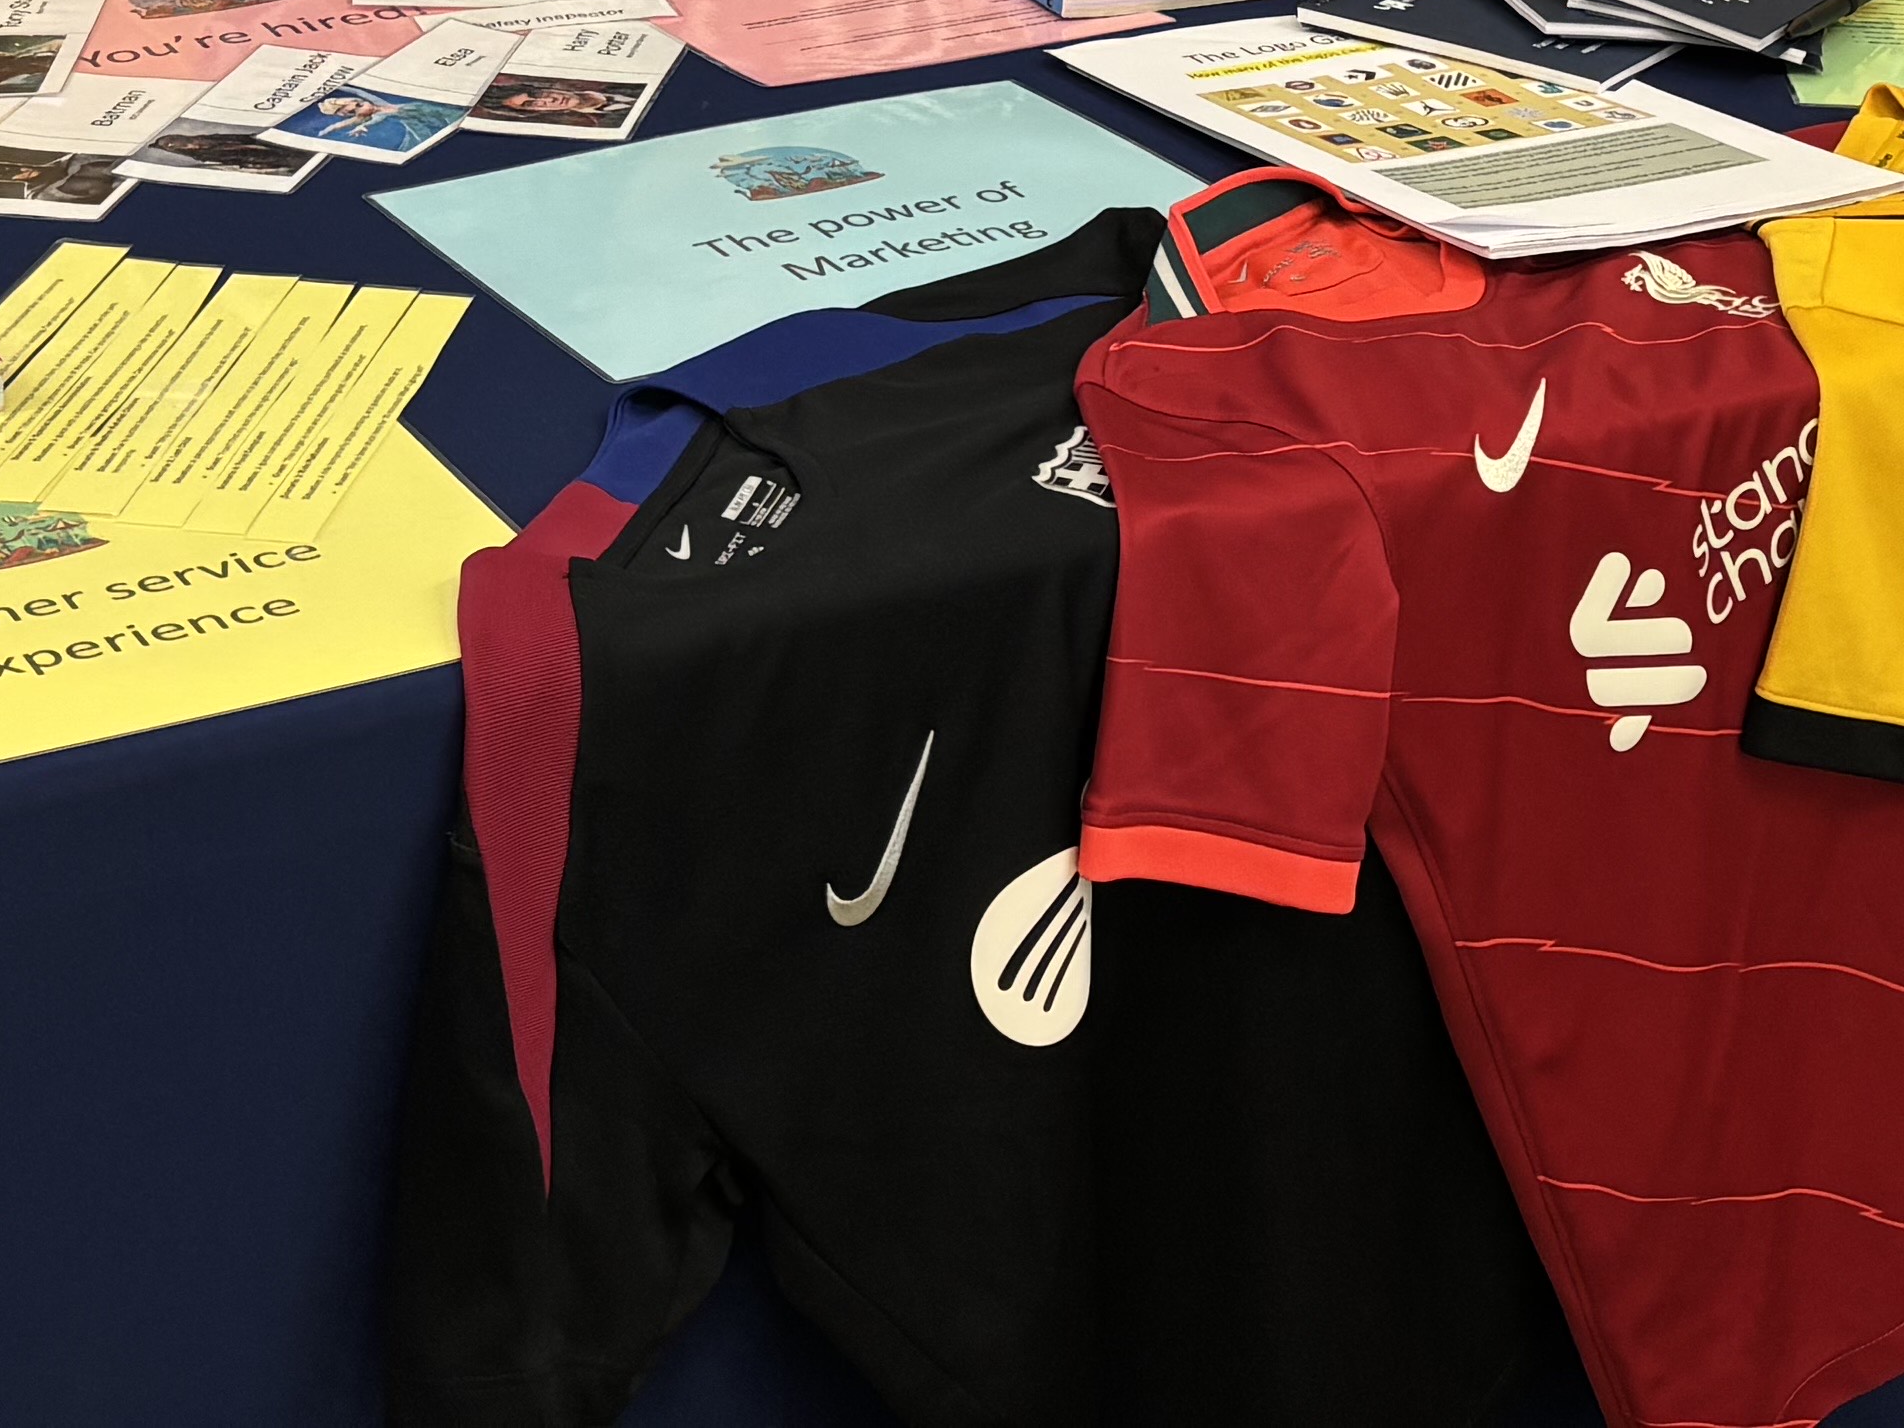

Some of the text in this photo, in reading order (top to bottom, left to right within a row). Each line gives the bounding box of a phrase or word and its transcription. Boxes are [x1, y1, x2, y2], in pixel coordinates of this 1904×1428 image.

[535, 8, 625, 24] Inspector
[434, 47, 476, 68] Elsa
[563, 28, 600, 53] Harry
[1182, 35, 1307, 65] The Logo
[91, 88, 147, 128] Batman
[254, 76, 304, 111] Captain
[692, 179, 1027, 259] The power of
[781, 219, 1049, 281] Marketing
[104, 544, 322, 604] service
